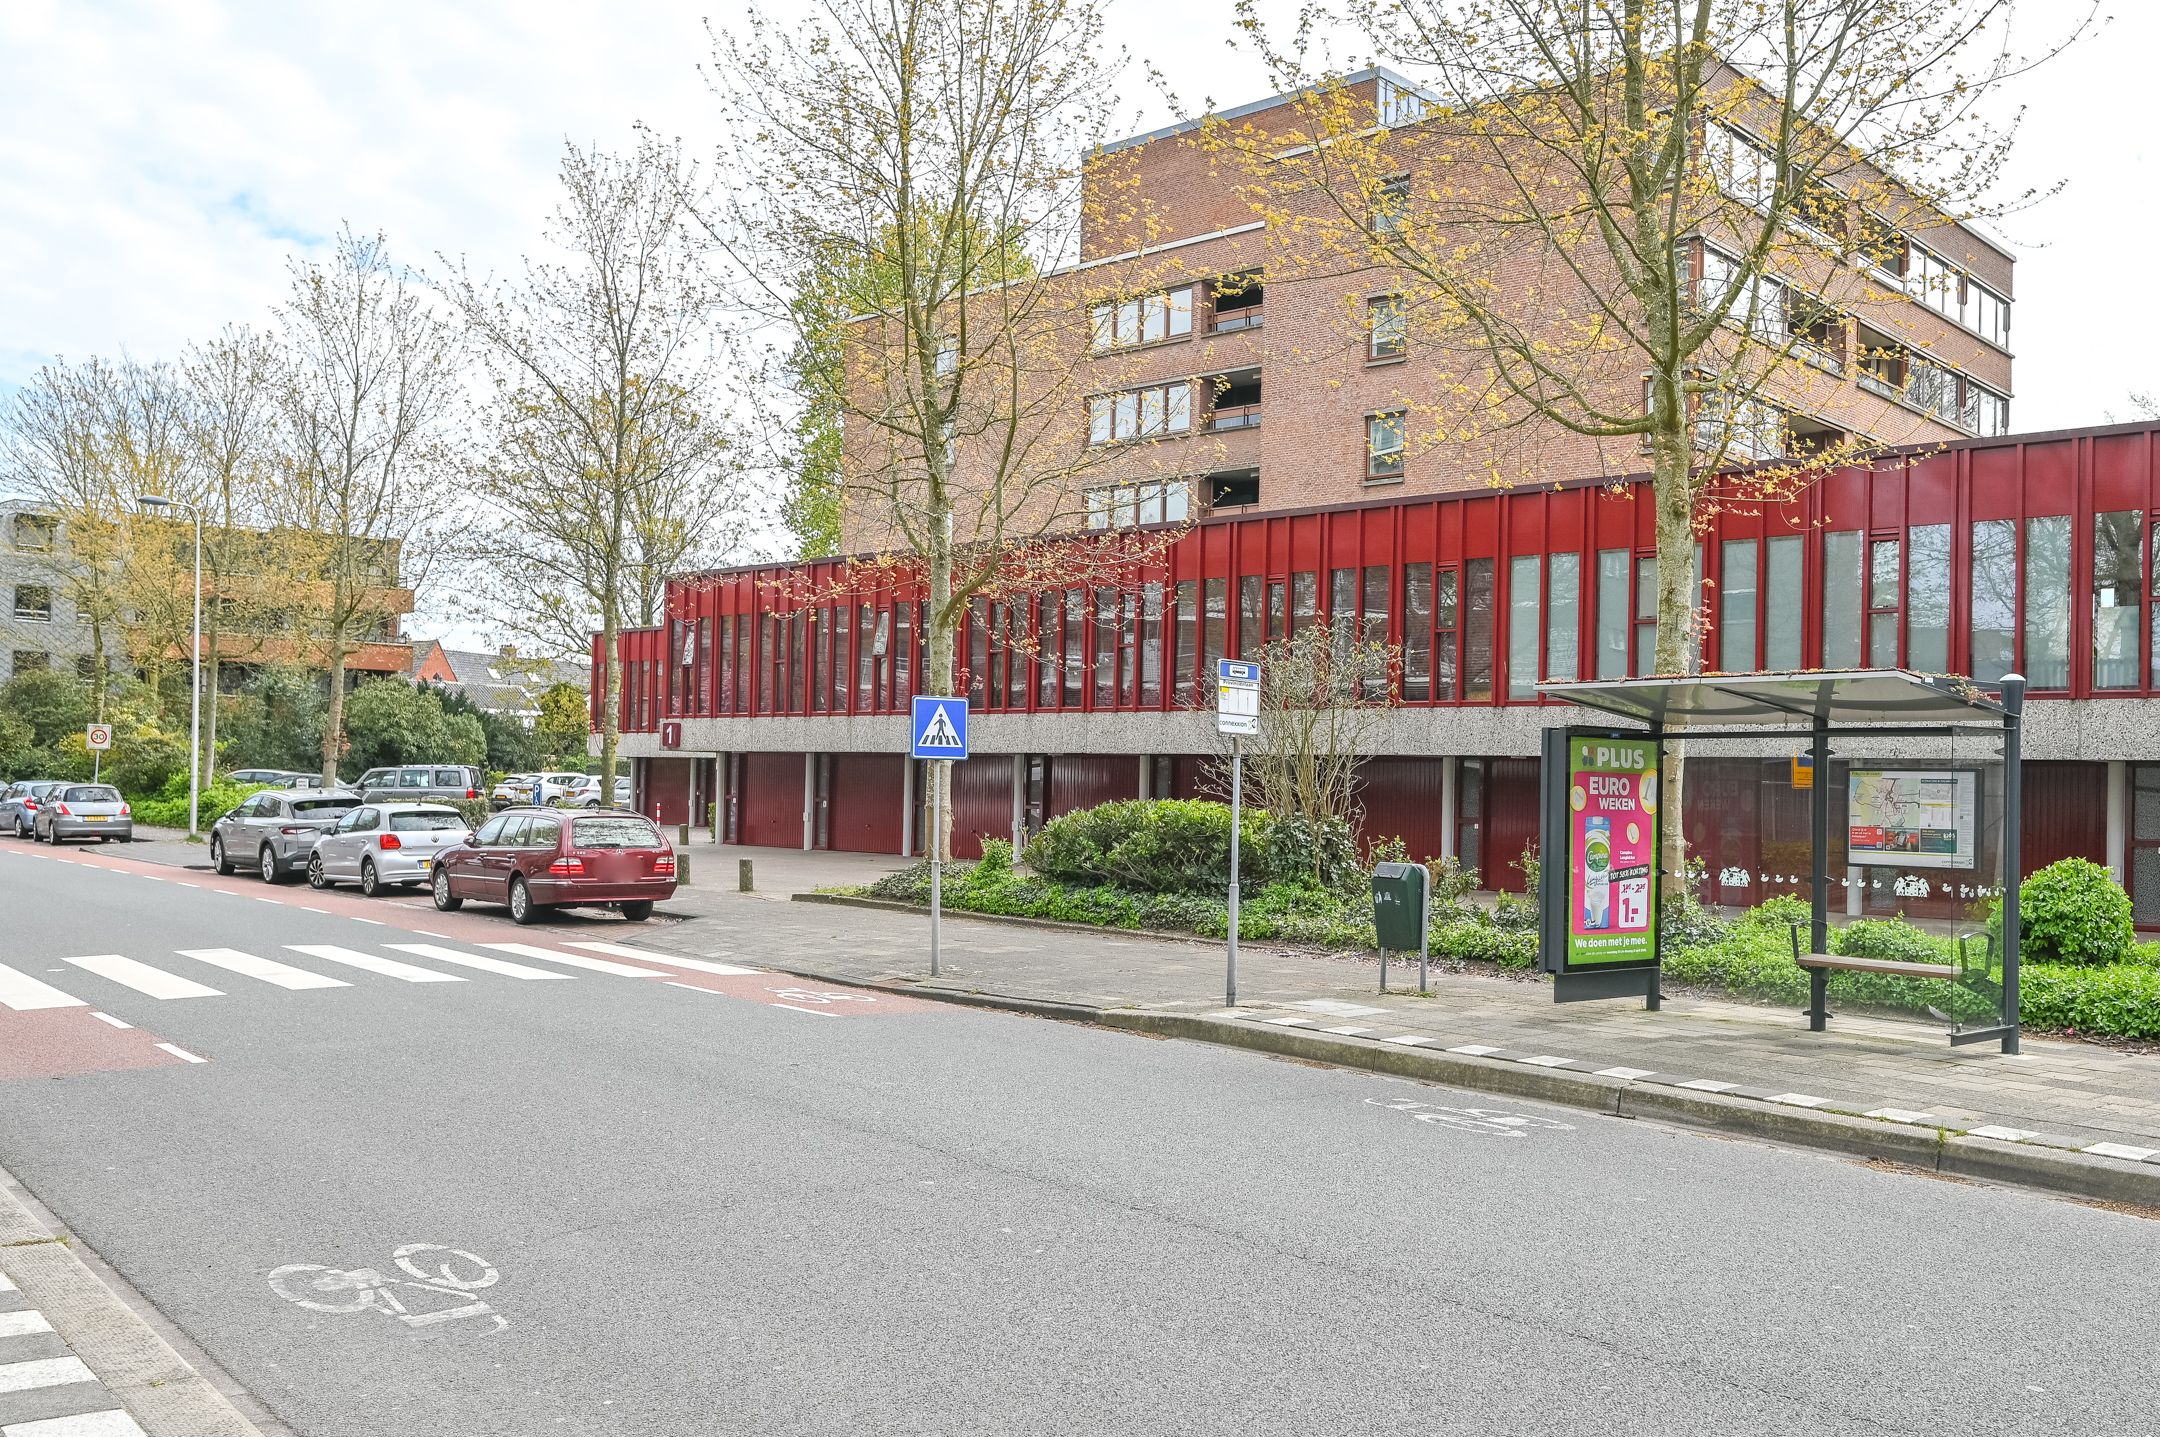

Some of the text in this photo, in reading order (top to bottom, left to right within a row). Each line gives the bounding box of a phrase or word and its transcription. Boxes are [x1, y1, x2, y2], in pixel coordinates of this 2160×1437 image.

[93, 733, 105, 741] 30
[666, 724, 673, 745] 1
[1597, 747, 1644, 769] PLUS
[534, 785, 540, 796] P
[1589, 776, 1630, 795] EURO
[1599, 797, 1635, 810] WEKEN
[1610, 872, 1619, 880] TOT
[1630, 866, 1649, 876] KORTING
[1575, 936, 1647, 948] We doen met je mee.
